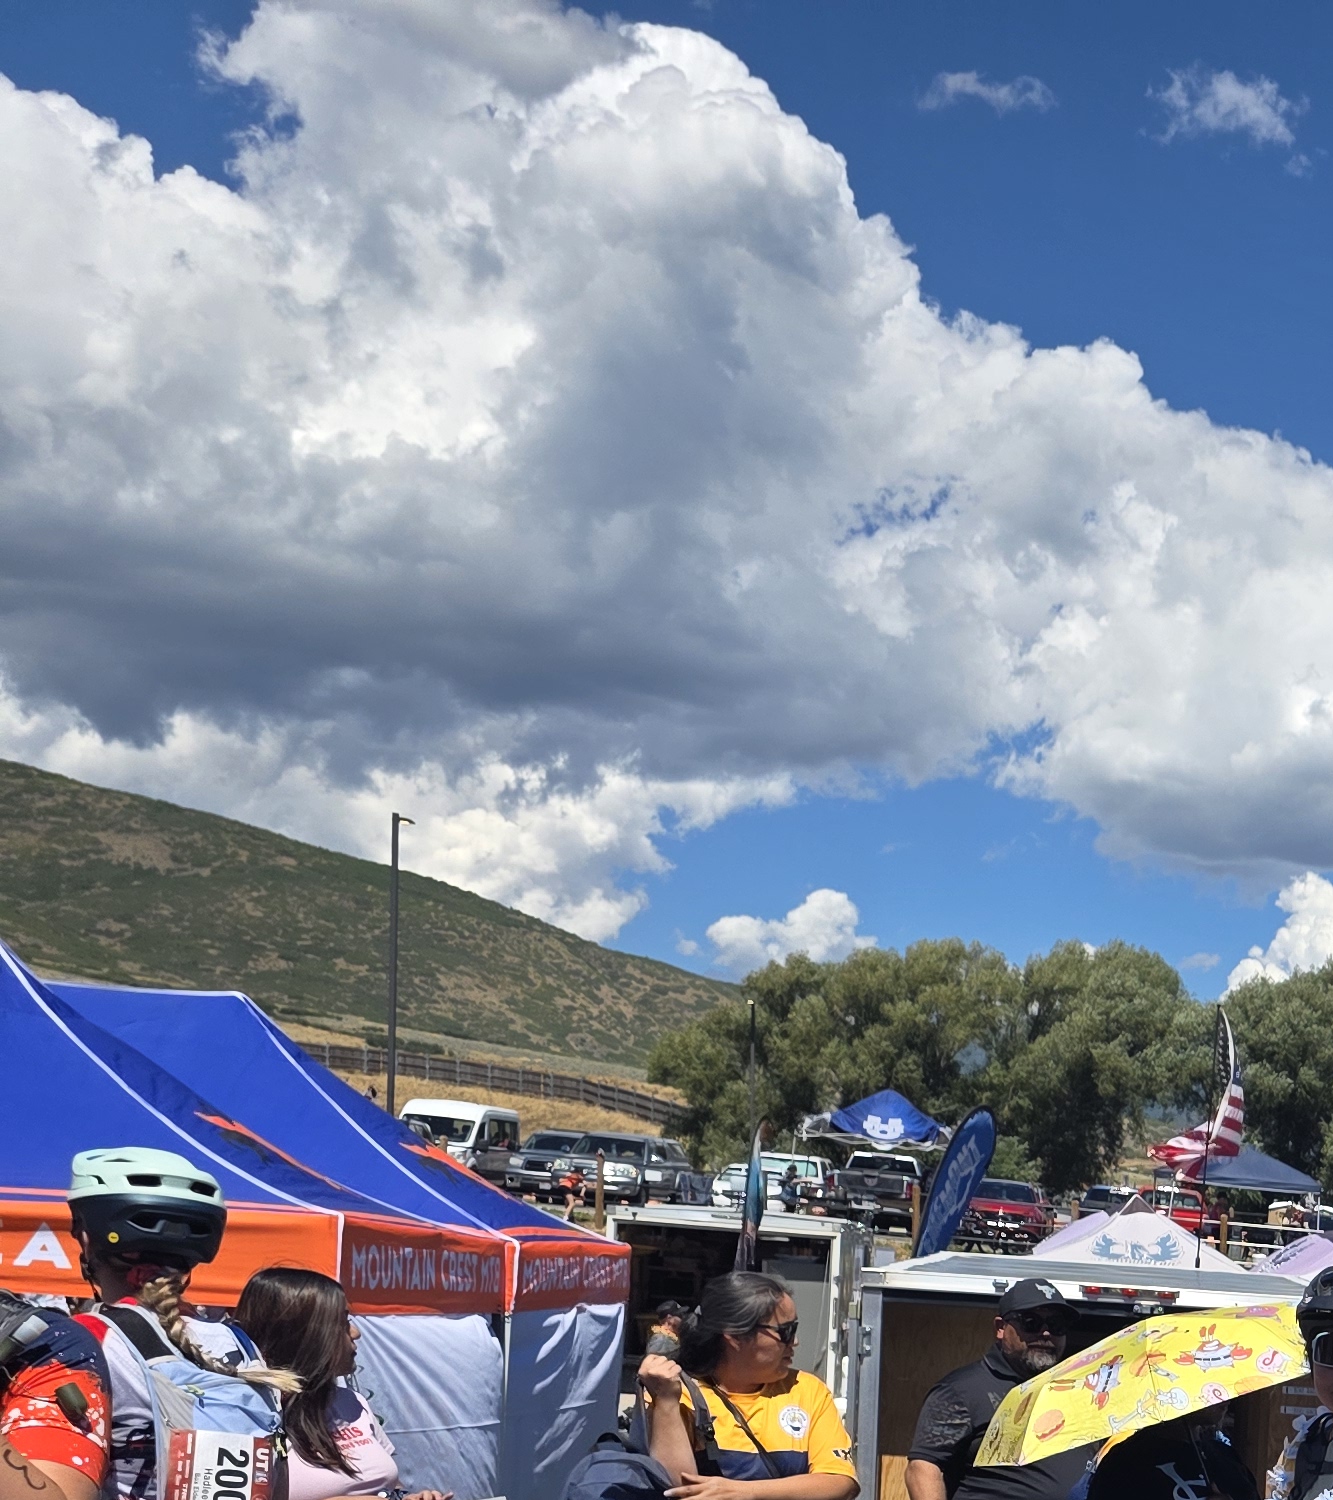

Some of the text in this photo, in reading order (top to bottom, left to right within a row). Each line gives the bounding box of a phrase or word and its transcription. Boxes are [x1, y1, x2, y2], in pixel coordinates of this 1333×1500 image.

[351, 1243, 500, 1293] MOUNTAIN CREST MTB
[522, 1257, 581, 1295] MOUNTAIN
[582, 1256, 611, 1288] CREST
[201, 1468, 213, 1499] Hadlee
